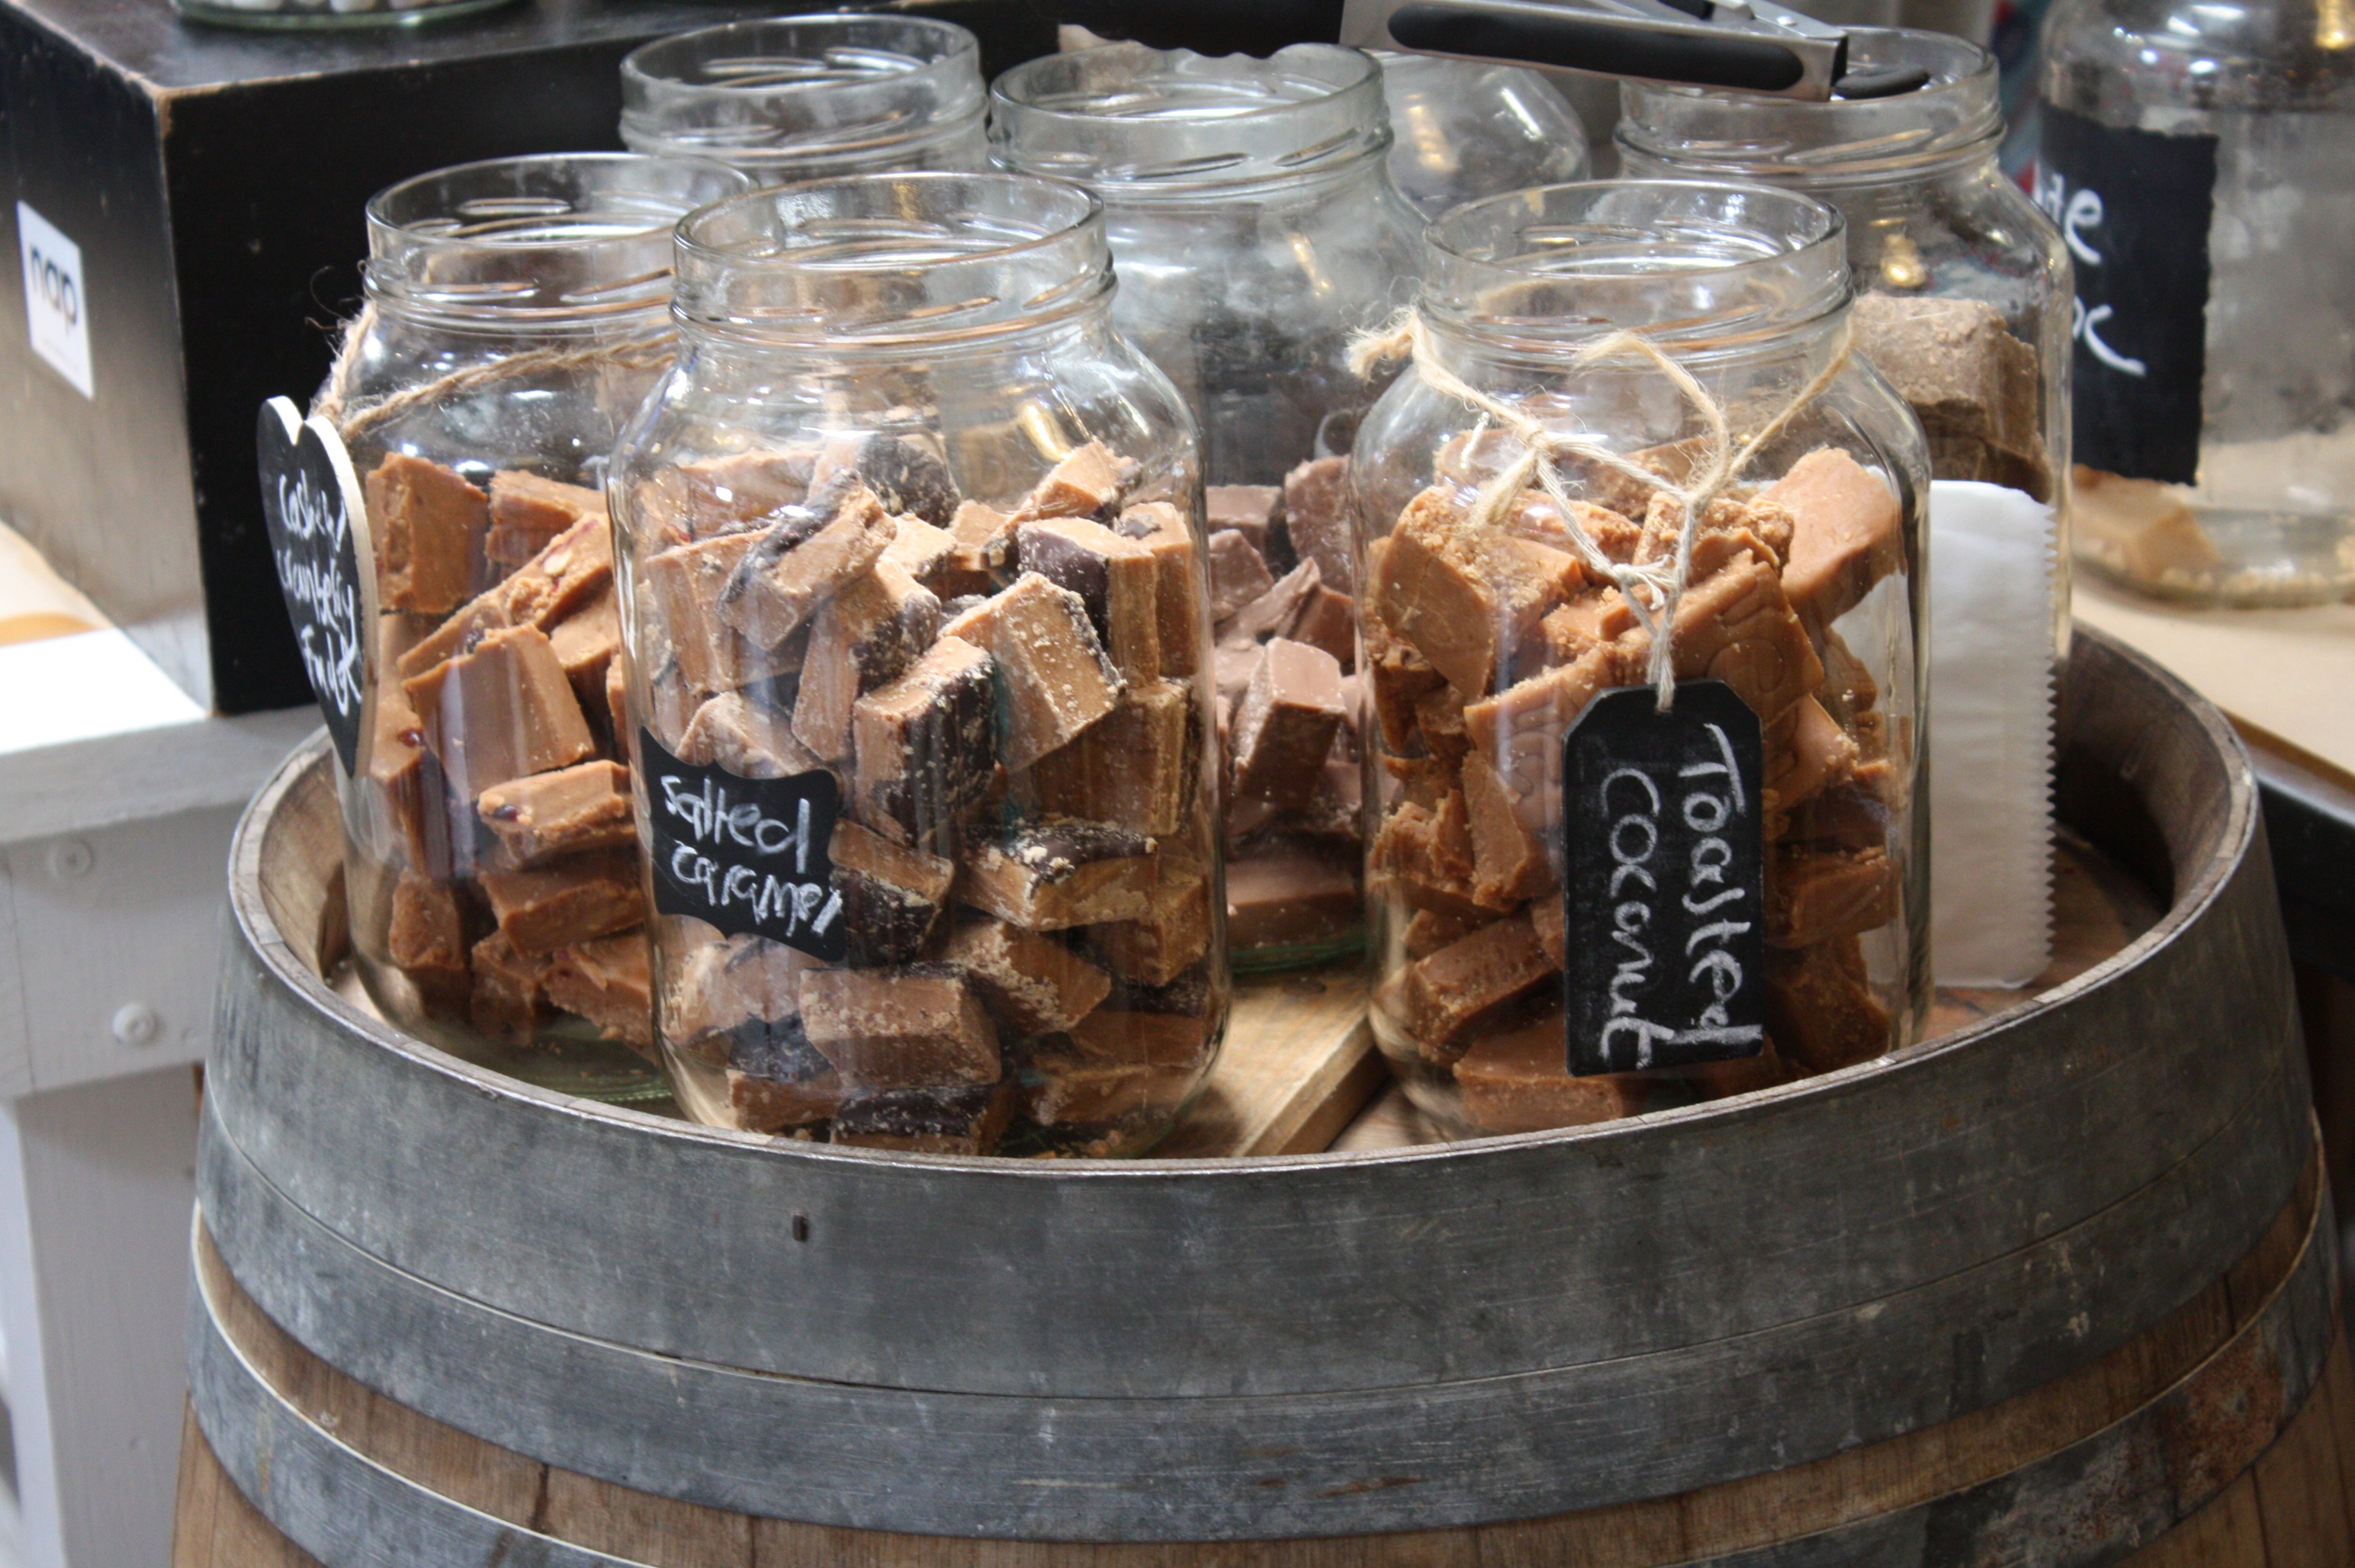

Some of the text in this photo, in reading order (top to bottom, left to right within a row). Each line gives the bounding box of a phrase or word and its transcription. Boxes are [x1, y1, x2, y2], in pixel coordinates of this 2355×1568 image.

[30, 243, 78, 336] nap
[660, 775, 811, 874] Salted
[1600, 767, 1676, 1069] Coconut
[1679, 722, 1764, 1045] Toasted
